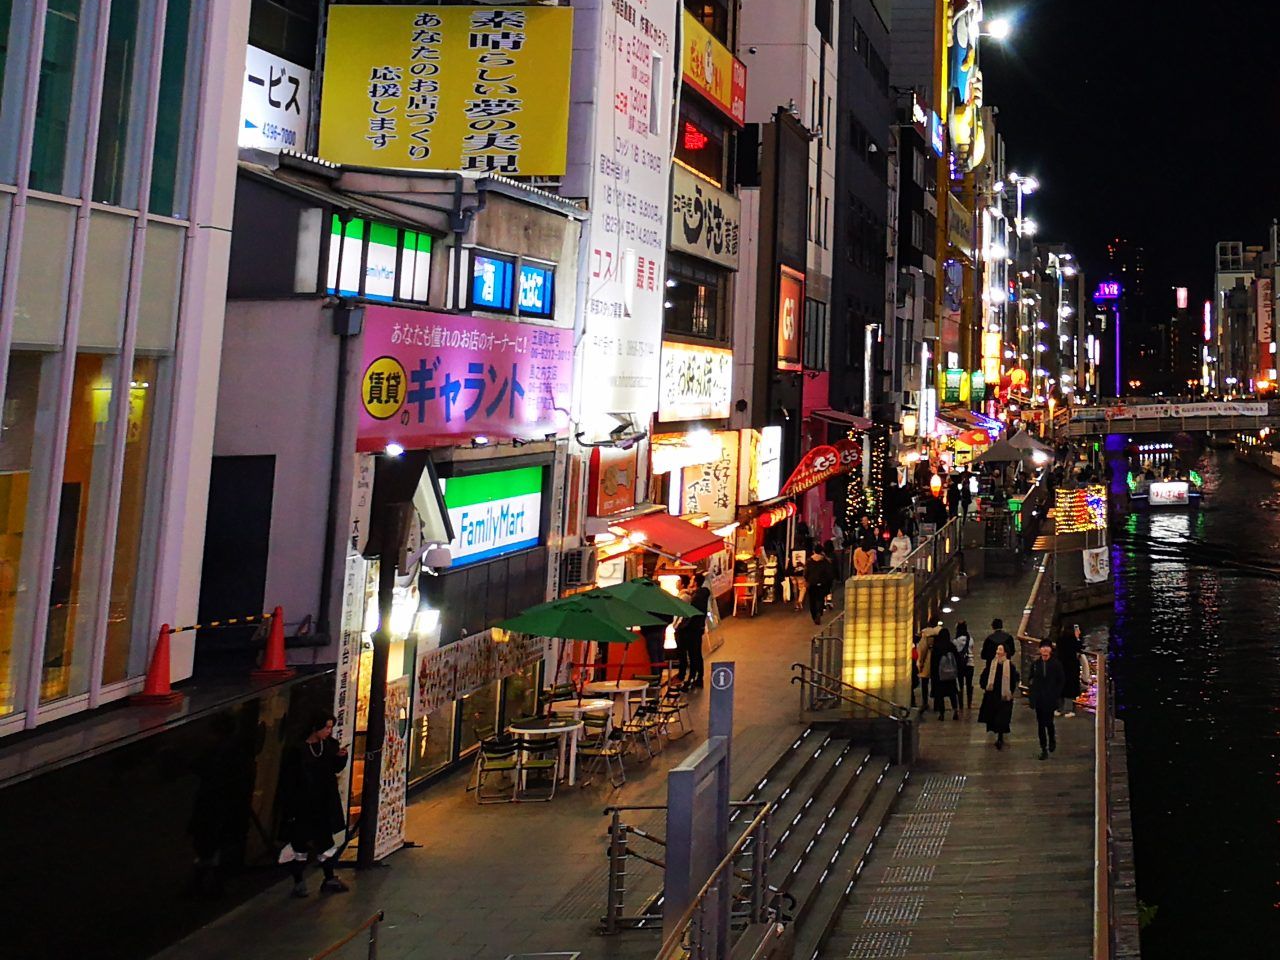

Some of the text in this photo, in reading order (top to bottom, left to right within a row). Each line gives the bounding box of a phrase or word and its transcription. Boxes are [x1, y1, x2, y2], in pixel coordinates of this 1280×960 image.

[365, 65, 402, 150] 応援します
[405, 11, 443, 161] あなたのお店づくり
[461, 10, 527, 174] 素晴らしい夢の実現
[482, 263, 496, 302] 酒
[519, 268, 543, 308] たばこ
[367, 371, 401, 405] 賃貸
[406, 355, 525, 424] ギャラント
[400, 409, 410, 426] の
[814, 452, 836, 471] G3
[459, 503, 525, 549] FamilyMart
